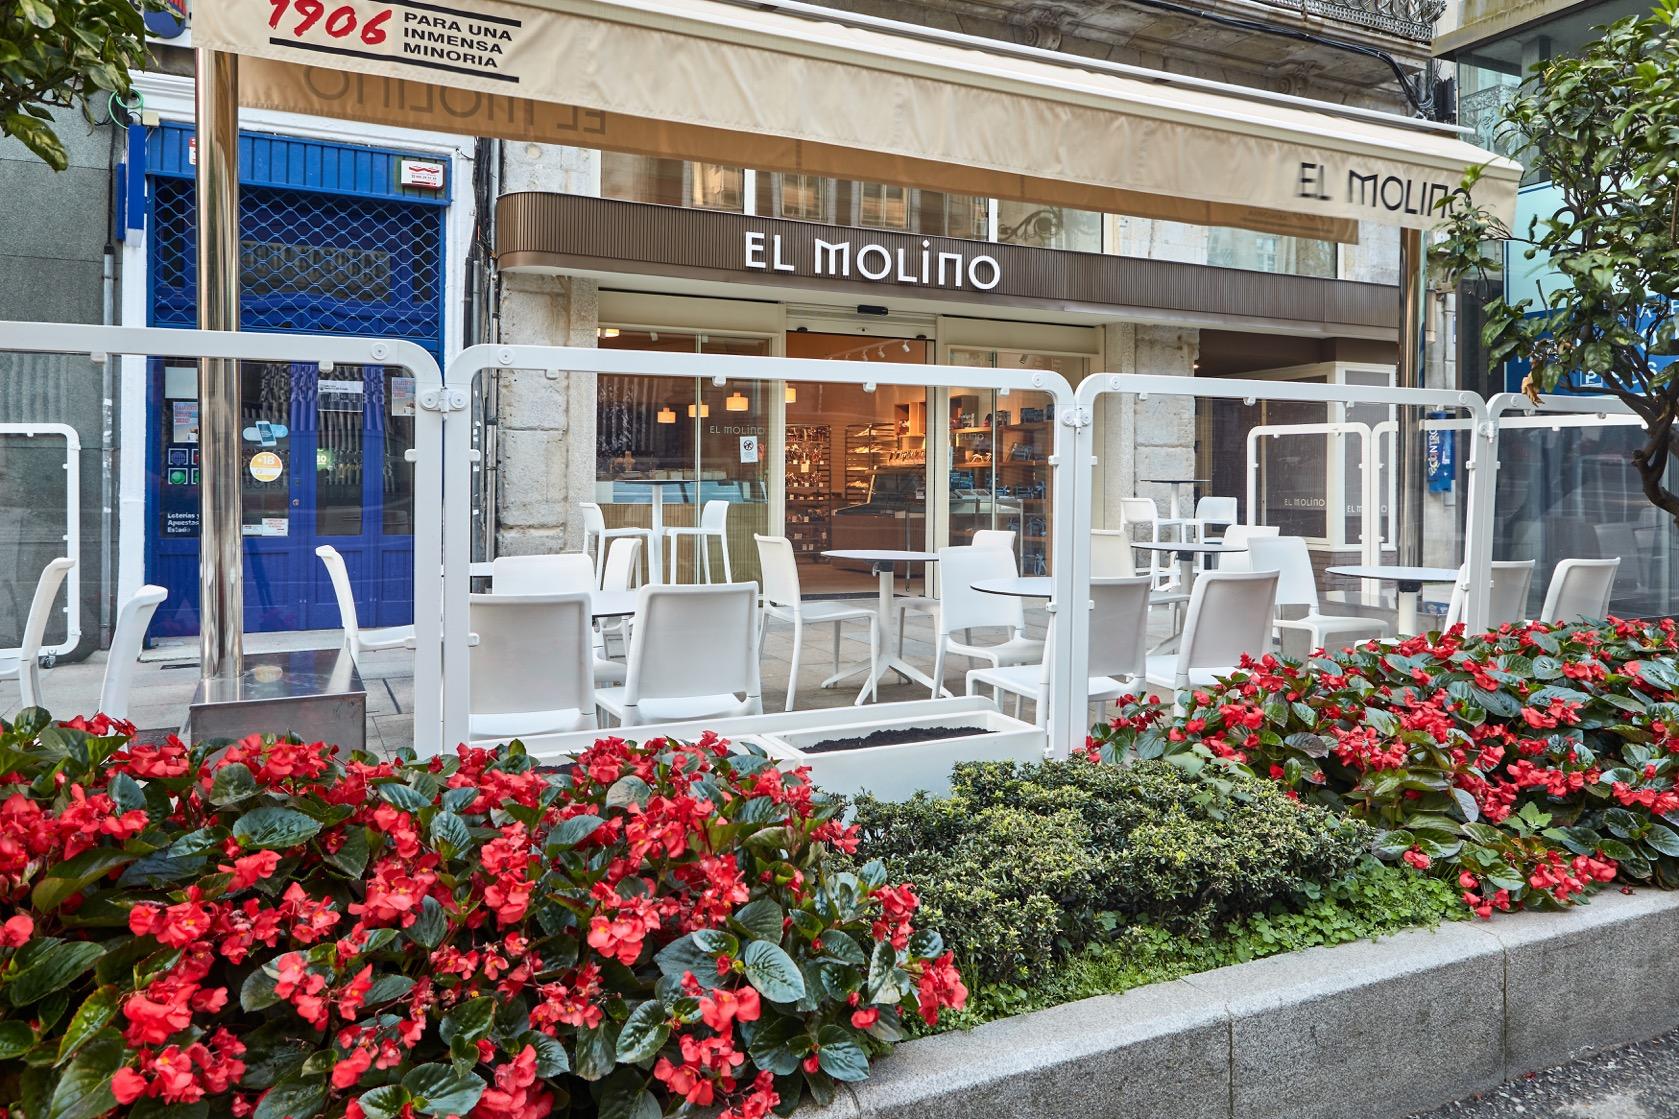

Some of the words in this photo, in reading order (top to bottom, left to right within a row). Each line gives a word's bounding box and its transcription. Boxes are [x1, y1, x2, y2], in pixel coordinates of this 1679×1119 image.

[269, 0, 392, 45] 1906
[404, 12, 462, 32] PARA
[468, 24, 513, 41] UNA
[404, 27, 503, 54] INMENSA
[403, 42, 498, 68] MINORIA
[1298, 162, 1331, 200] EL
[746, 231, 795, 271] EL
[815, 239, 1001, 290] MOLINO
[709, 425, 721, 434] EL
[724, 424, 765, 435] MOLINO
[1284, 498, 1293, 506] EL
[1347, 505, 1355, 513] EL
